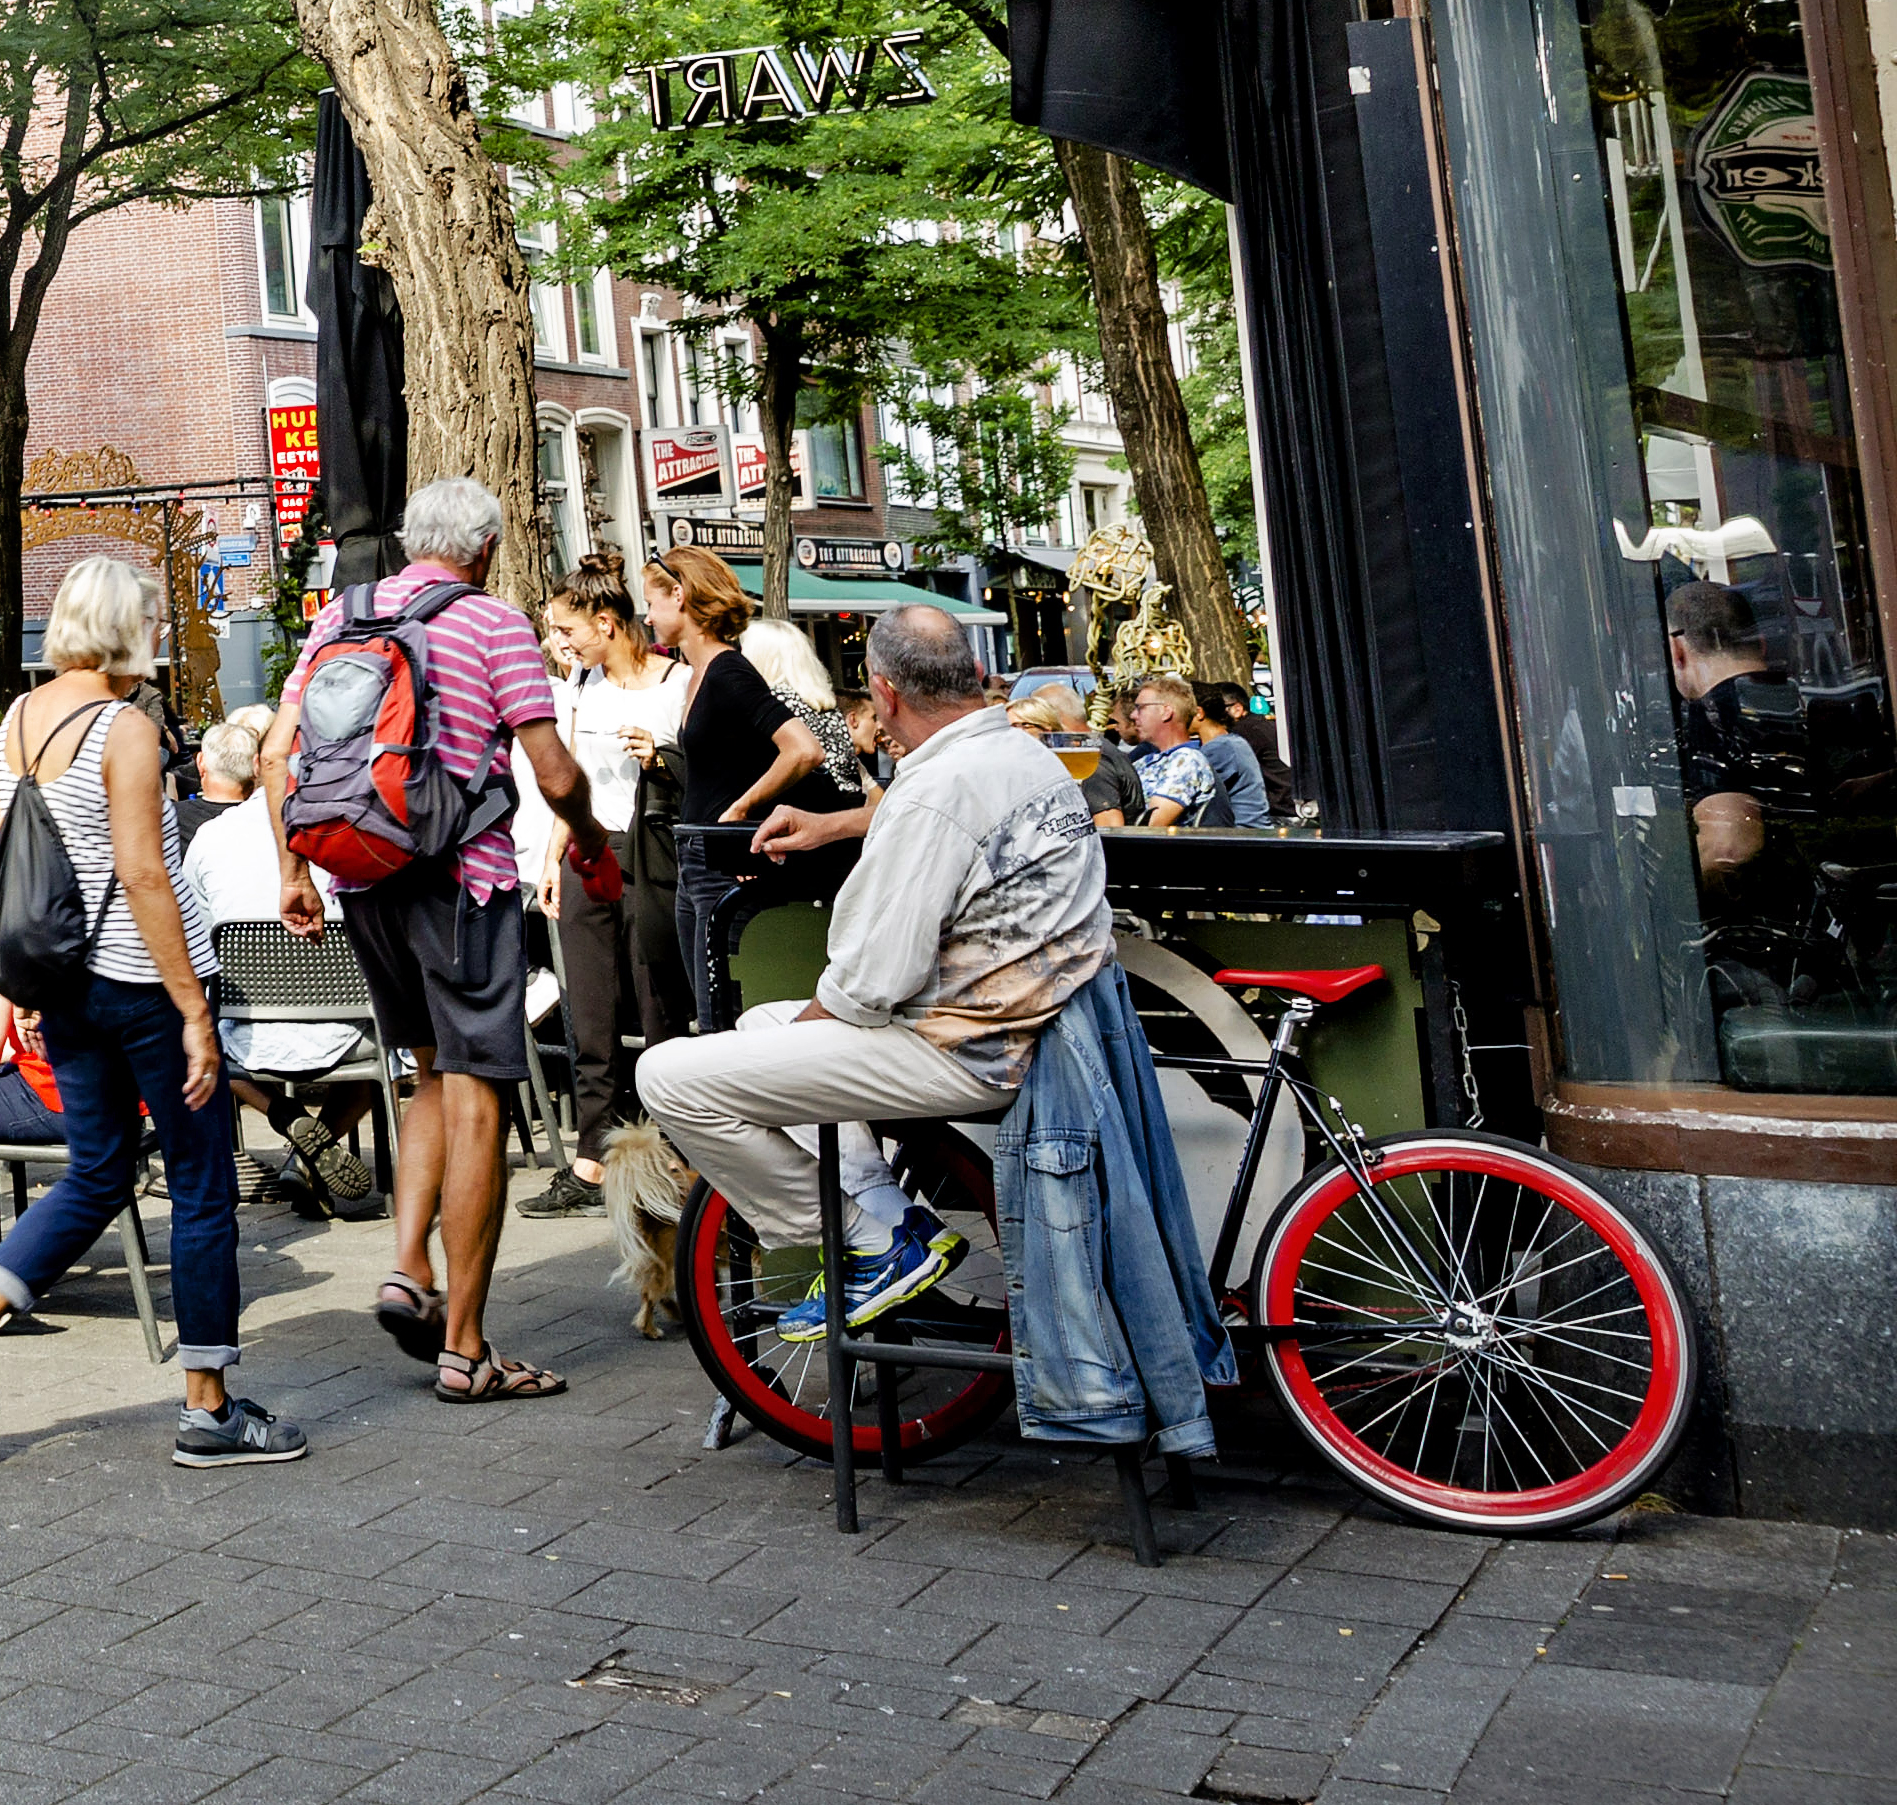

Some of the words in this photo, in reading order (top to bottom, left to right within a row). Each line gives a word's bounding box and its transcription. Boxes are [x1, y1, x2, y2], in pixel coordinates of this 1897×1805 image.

[654, 442, 674, 459] THE
[737, 447, 756, 464] THE
[243, 1421, 269, 1449] N
